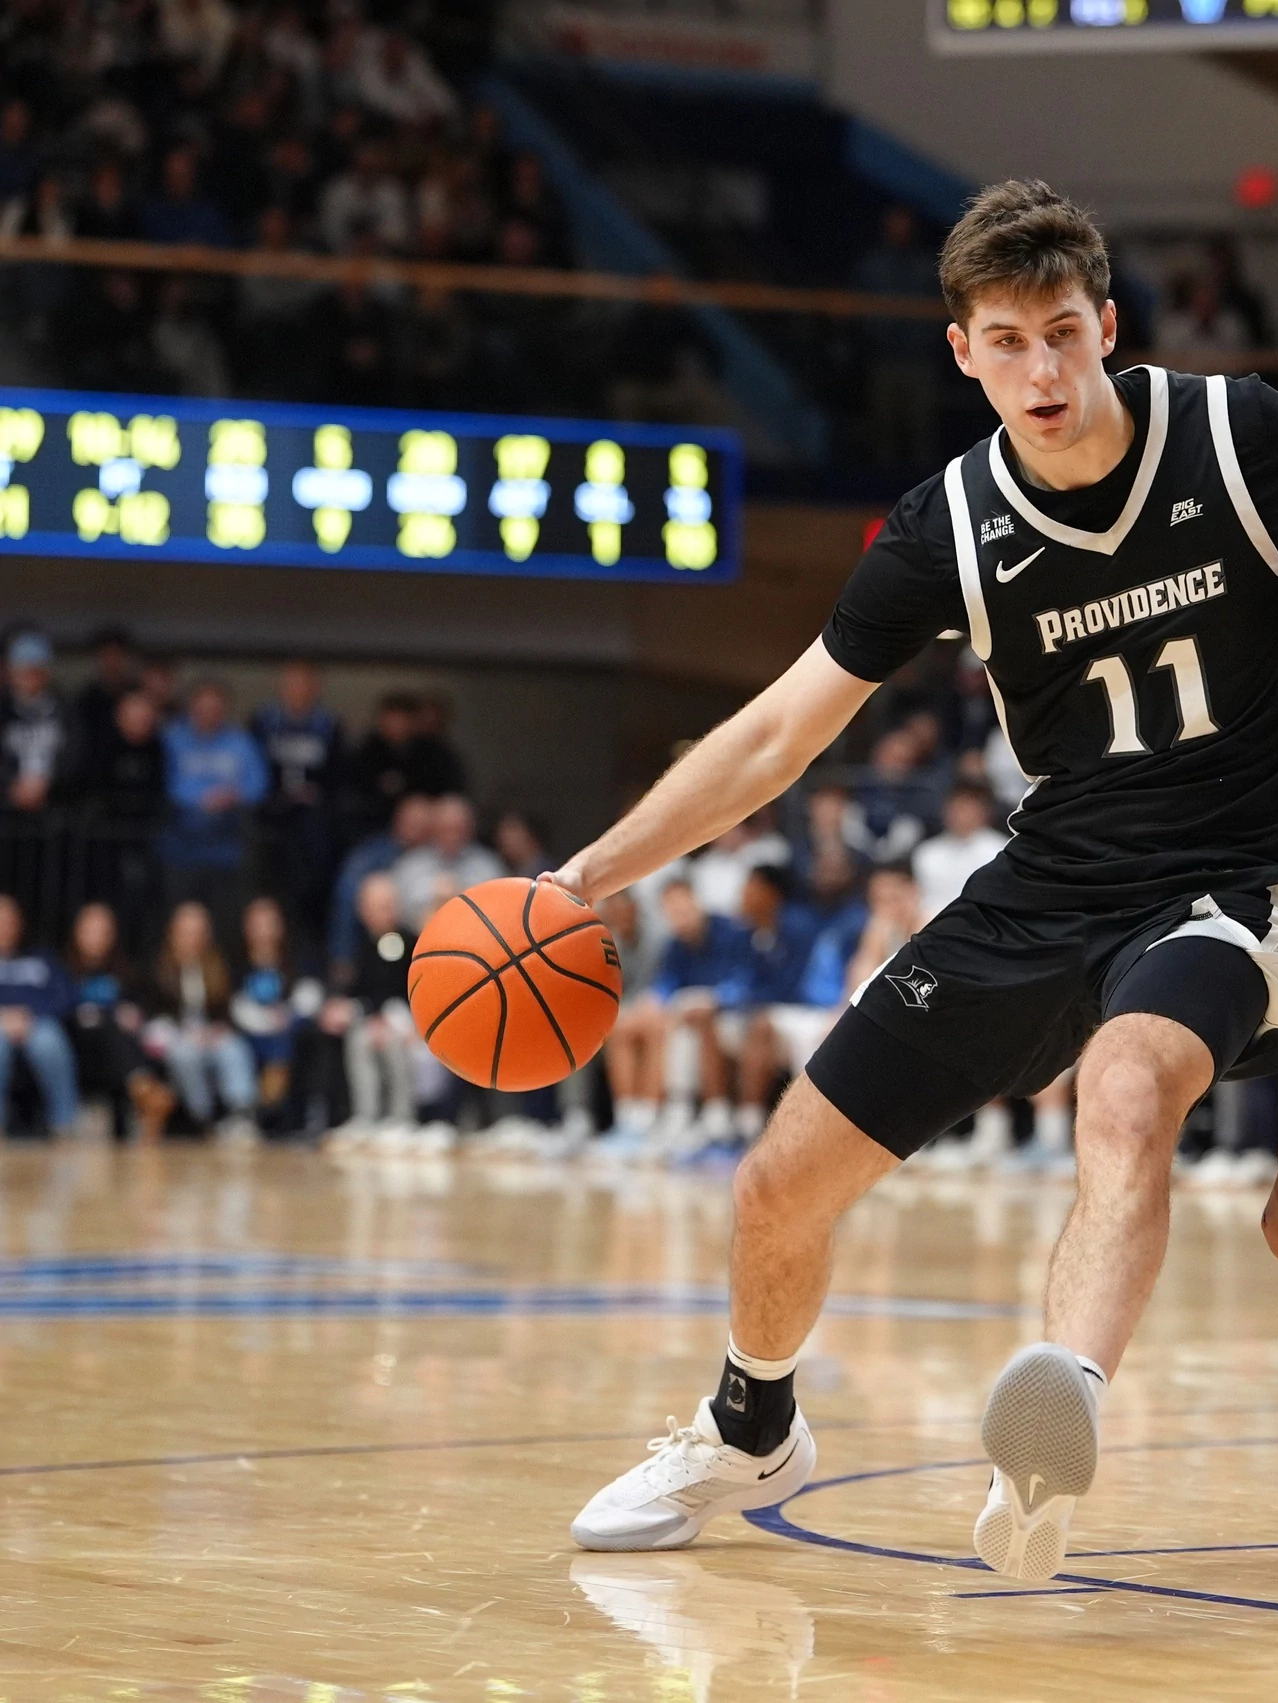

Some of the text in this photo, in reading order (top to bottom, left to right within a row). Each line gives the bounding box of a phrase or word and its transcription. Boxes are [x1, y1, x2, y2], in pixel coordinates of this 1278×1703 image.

[1171, 504, 1204, 522] EAST
[1172, 498, 1195, 513] BIG
[980, 514, 1011, 535] BE THE
[980, 523, 1015, 545] CHANGE
[1033, 559, 1227, 654] PROVIDENCE
[1081, 634, 1224, 758] 11
